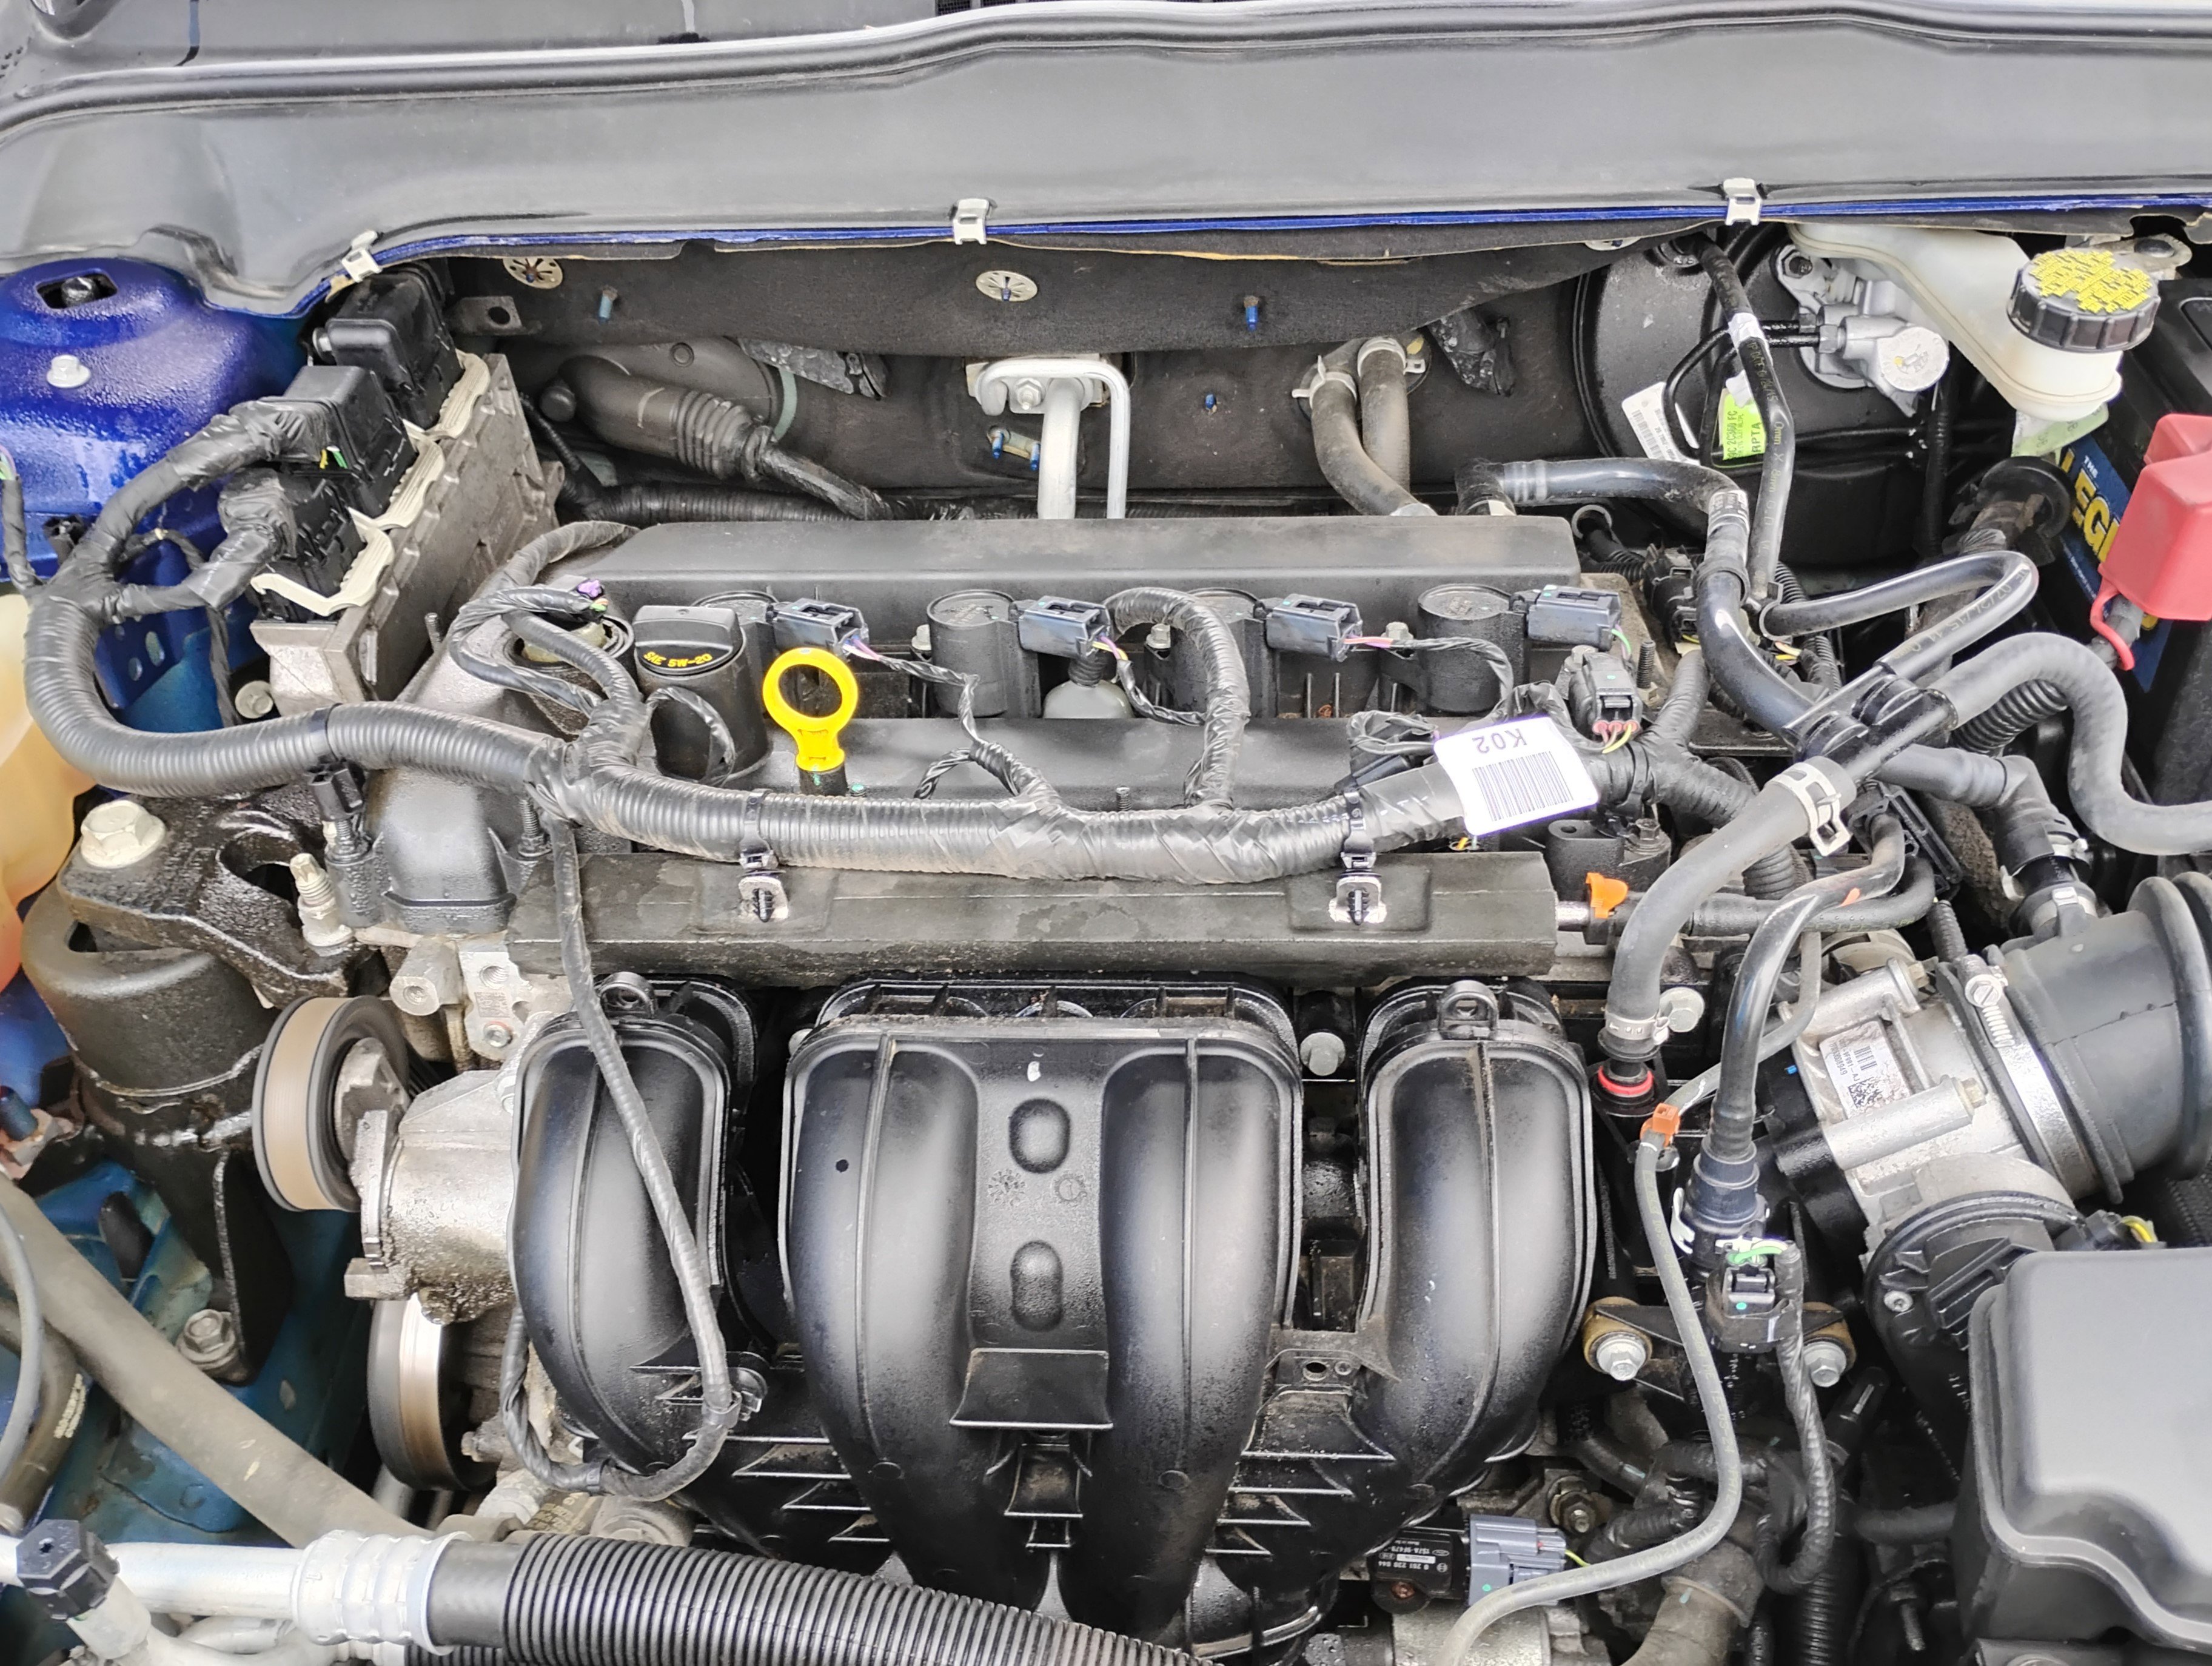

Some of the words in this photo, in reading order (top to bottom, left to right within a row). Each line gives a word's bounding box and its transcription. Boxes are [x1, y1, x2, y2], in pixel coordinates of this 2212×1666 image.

[1751, 422, 1762, 454] RPTA
[2083, 455, 2099, 478] THE
[643, 651, 666, 665] SAE
[668, 653, 713, 667] 5W-20
[1472, 728, 1527, 754] K02
